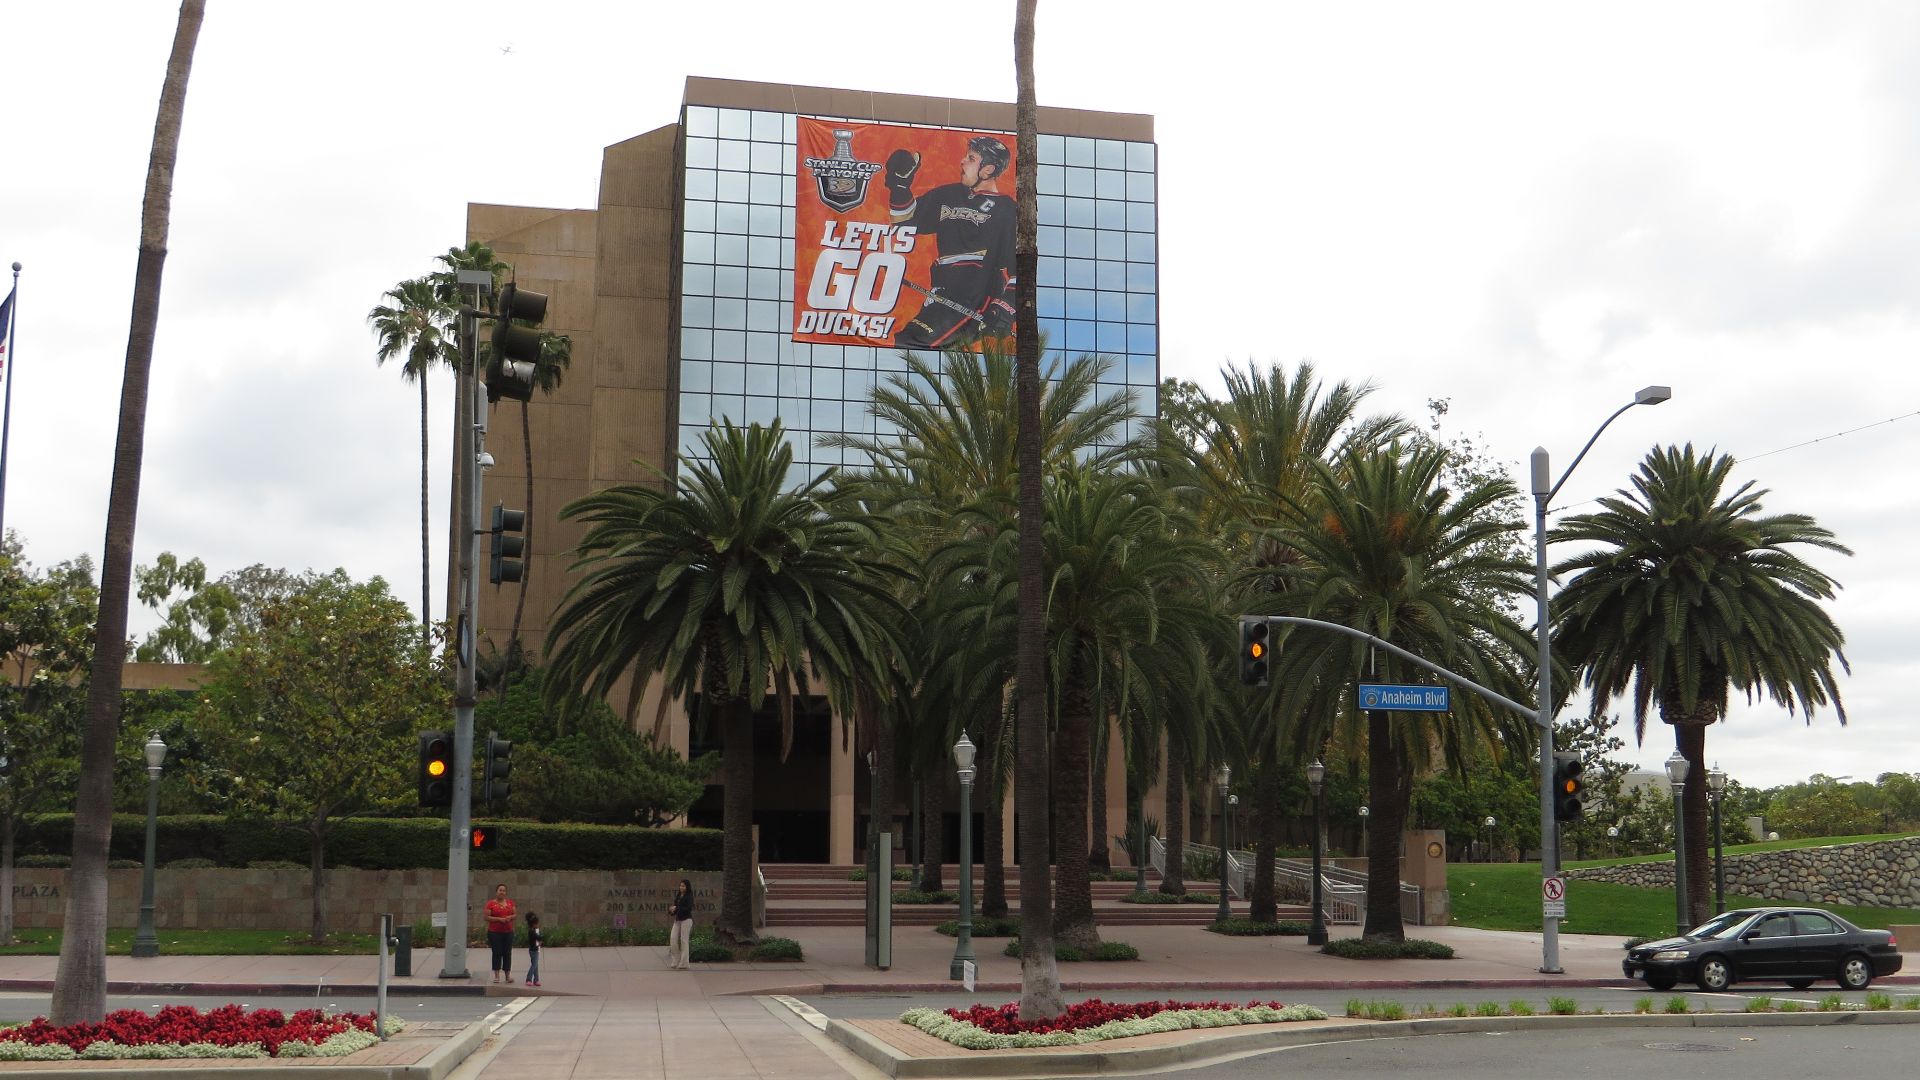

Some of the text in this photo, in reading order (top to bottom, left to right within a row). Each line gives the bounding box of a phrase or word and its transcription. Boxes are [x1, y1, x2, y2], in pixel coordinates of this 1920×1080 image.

[804, 157, 882, 172] STANLEY CUP
[812, 168, 872, 180] PLAYOFFS
[979, 198, 996, 213] C
[820, 220, 917, 253] LET'S
[806, 248, 906, 314] GO
[796, 310, 896, 339] DUCKS!
[1381, 690, 1422, 705] Anaheim
[1425, 691, 1445, 706] Blvd
[12, 885, 60, 897] PLAZA
[608, 888, 656, 897] ANAHEIM
[661, 888, 681, 897] CIT
[606, 902, 624, 912] 200
